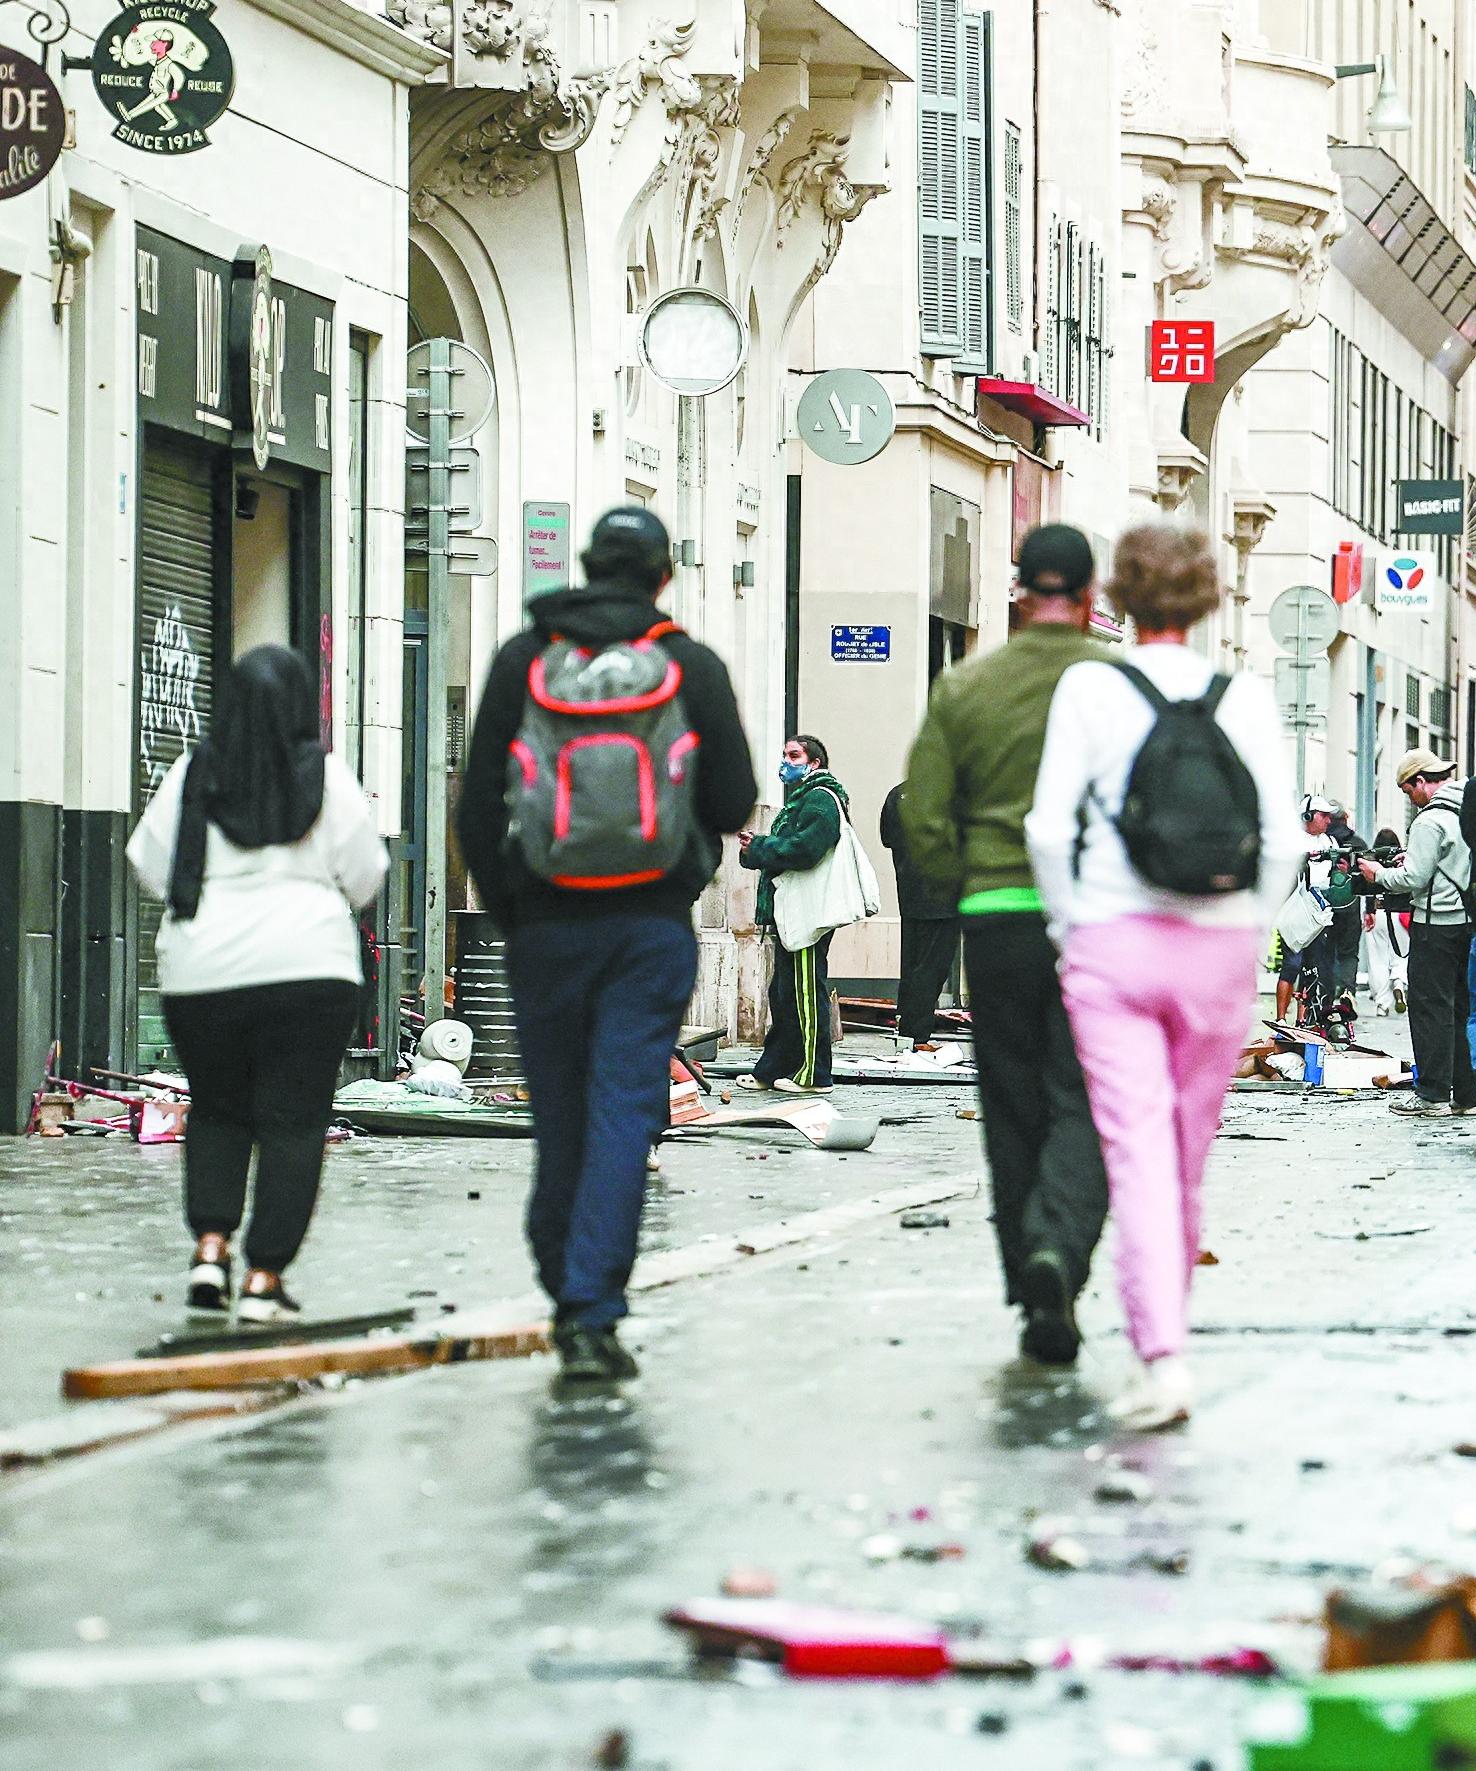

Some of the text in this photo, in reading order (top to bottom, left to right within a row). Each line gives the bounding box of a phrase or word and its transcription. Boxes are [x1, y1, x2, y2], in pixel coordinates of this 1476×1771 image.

[140, 7, 189, 22] RECYCLE
[100, 73, 223, 94] REDUCE REUSE
[116, 125, 204, 151] SINCE 1974
